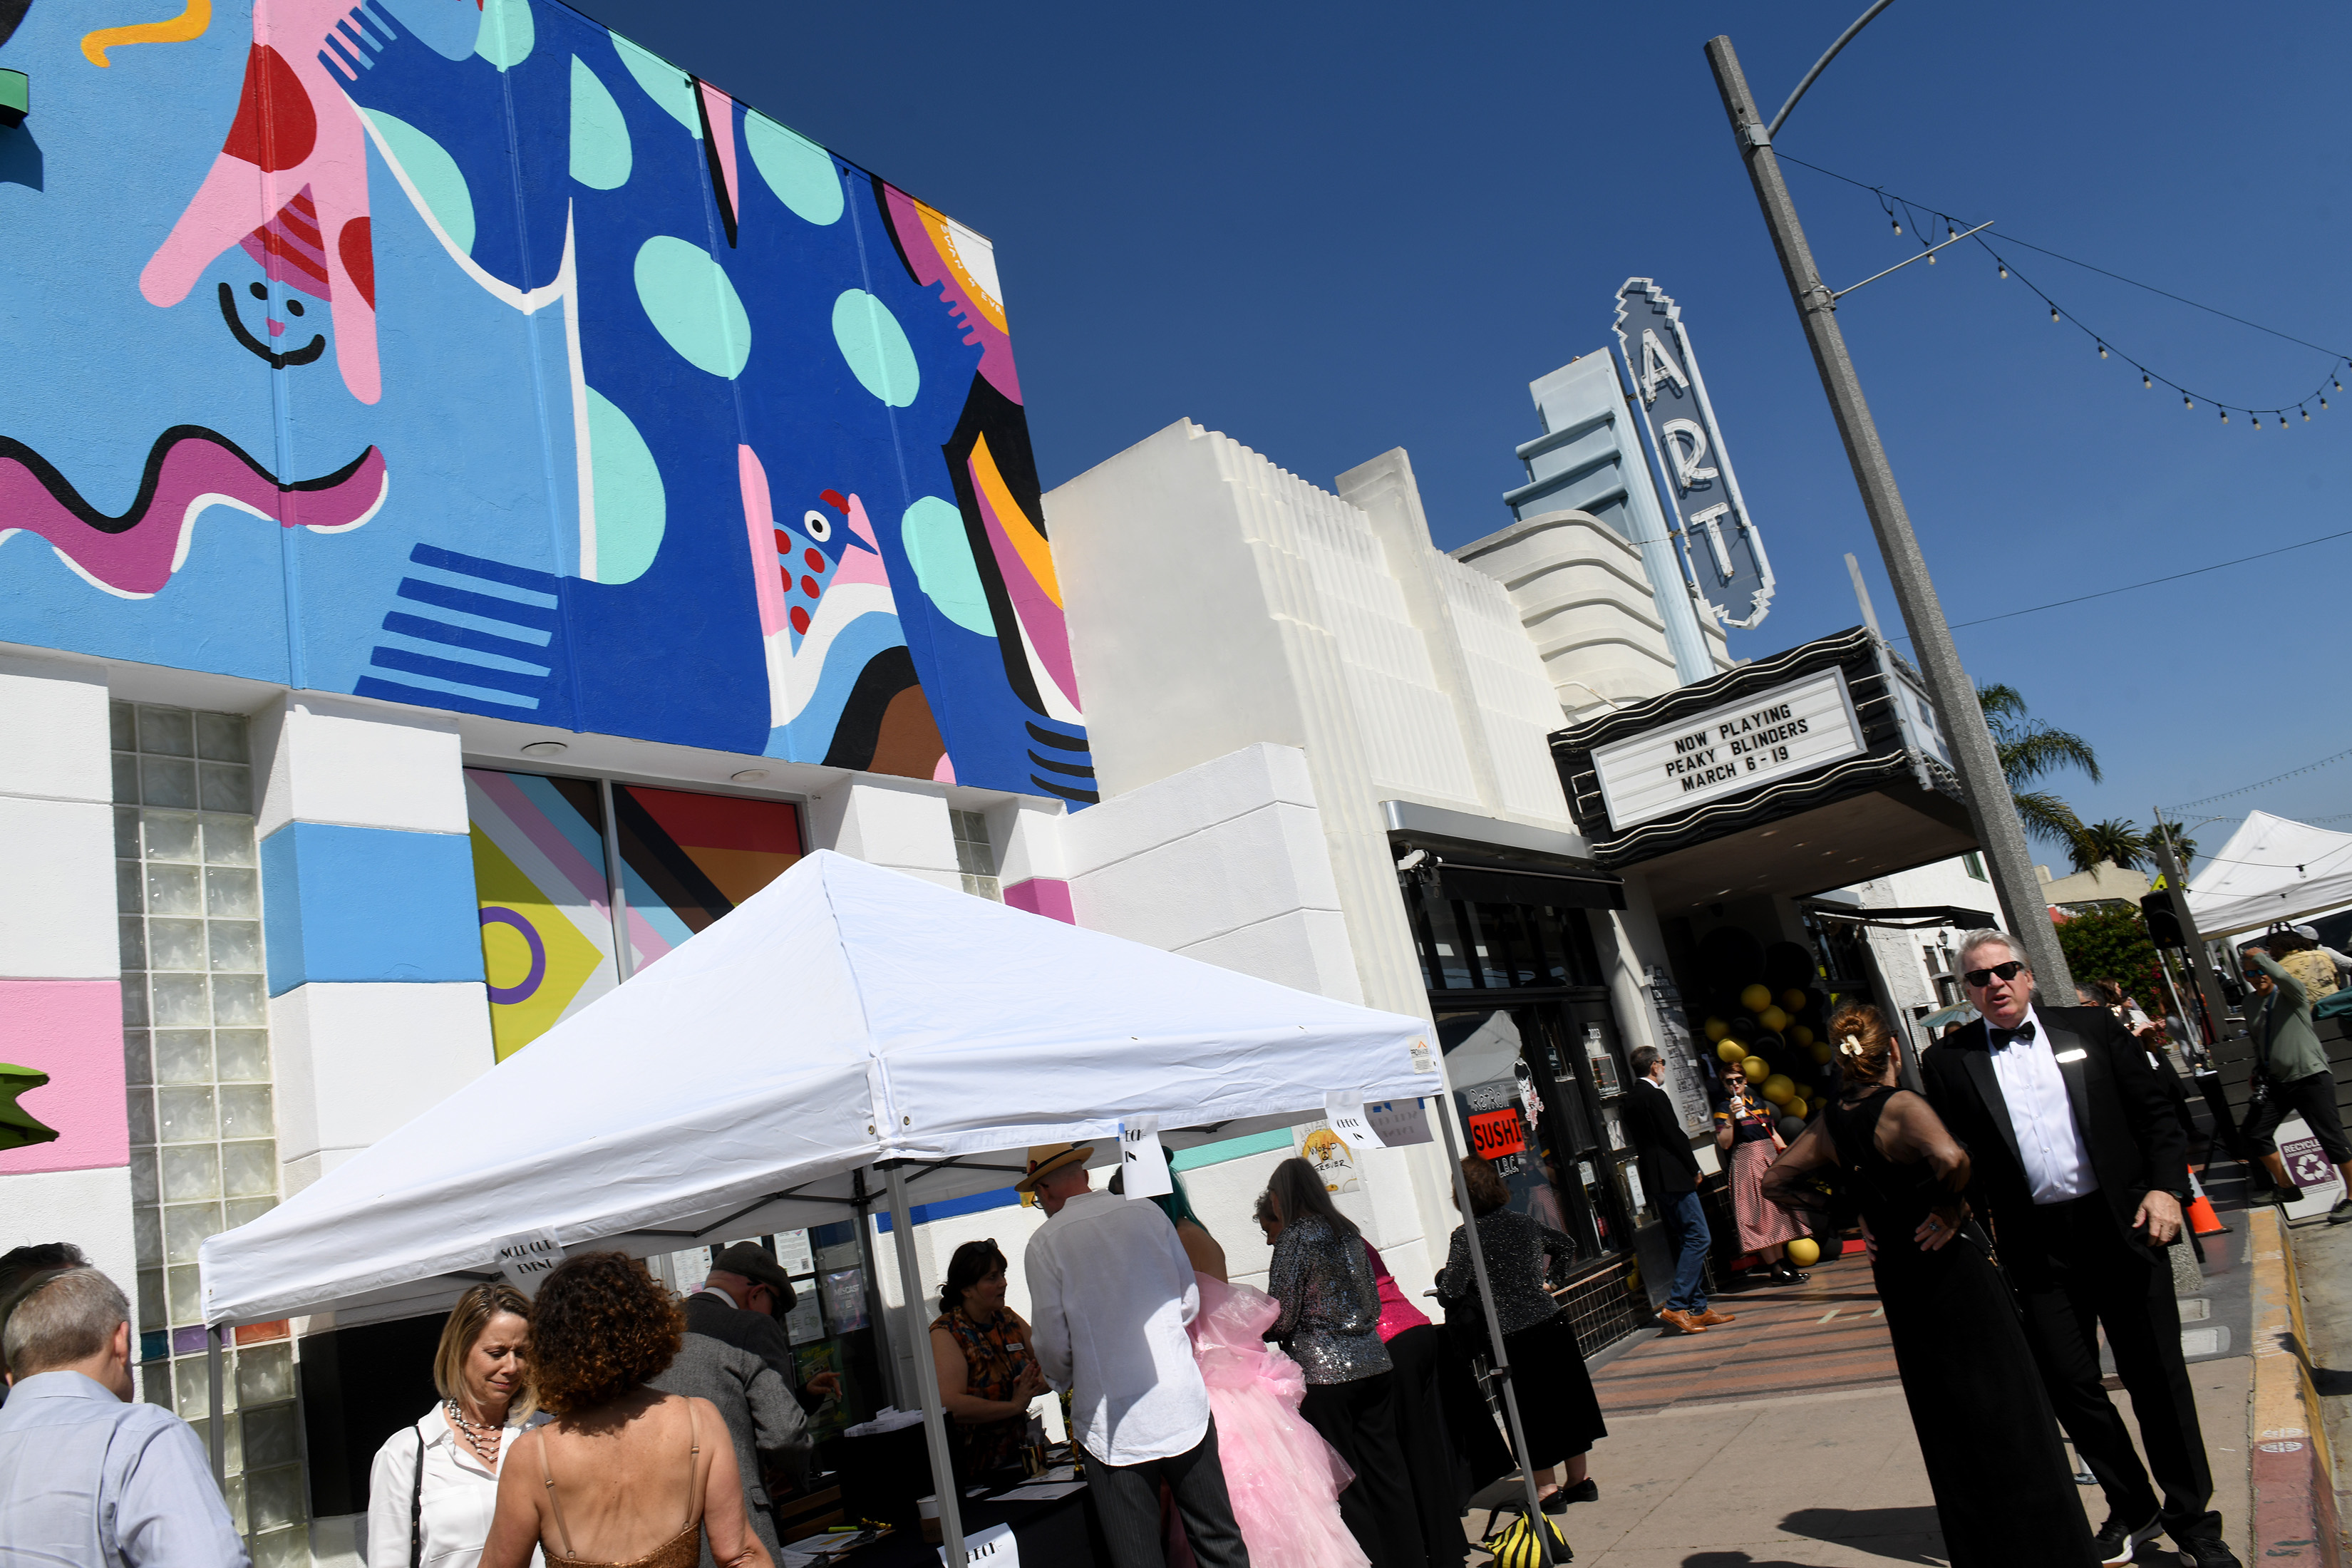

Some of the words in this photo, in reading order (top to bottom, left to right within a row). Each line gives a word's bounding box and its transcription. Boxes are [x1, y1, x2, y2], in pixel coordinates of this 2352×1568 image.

[968, 277, 976, 287] 4
[981, 291, 1004, 316] EVR
[1641, 328, 1735, 578] ART
[1675, 731, 1707, 754] NOW
[1719, 703, 1791, 739] PLAYING
[1666, 748, 1715, 777] PEAKY
[1731, 718, 1808, 755] BLINDERS
[1681, 763, 1737, 792] MARCH
[1473, 1118, 1522, 1151] SUSHI
[2283, 1138, 2321, 1153] RECYCLE
[1125, 1150, 1137, 1162] IN
[1307, 1140, 1337, 1155] WORLD
[1314, 1160, 1352, 1172] REVER
[500, 1244, 528, 1259] SOLD
[529, 1239, 552, 1253] OUT
[517, 1258, 553, 1274] EVENT
[965, 1540, 1003, 1564] HECK-
